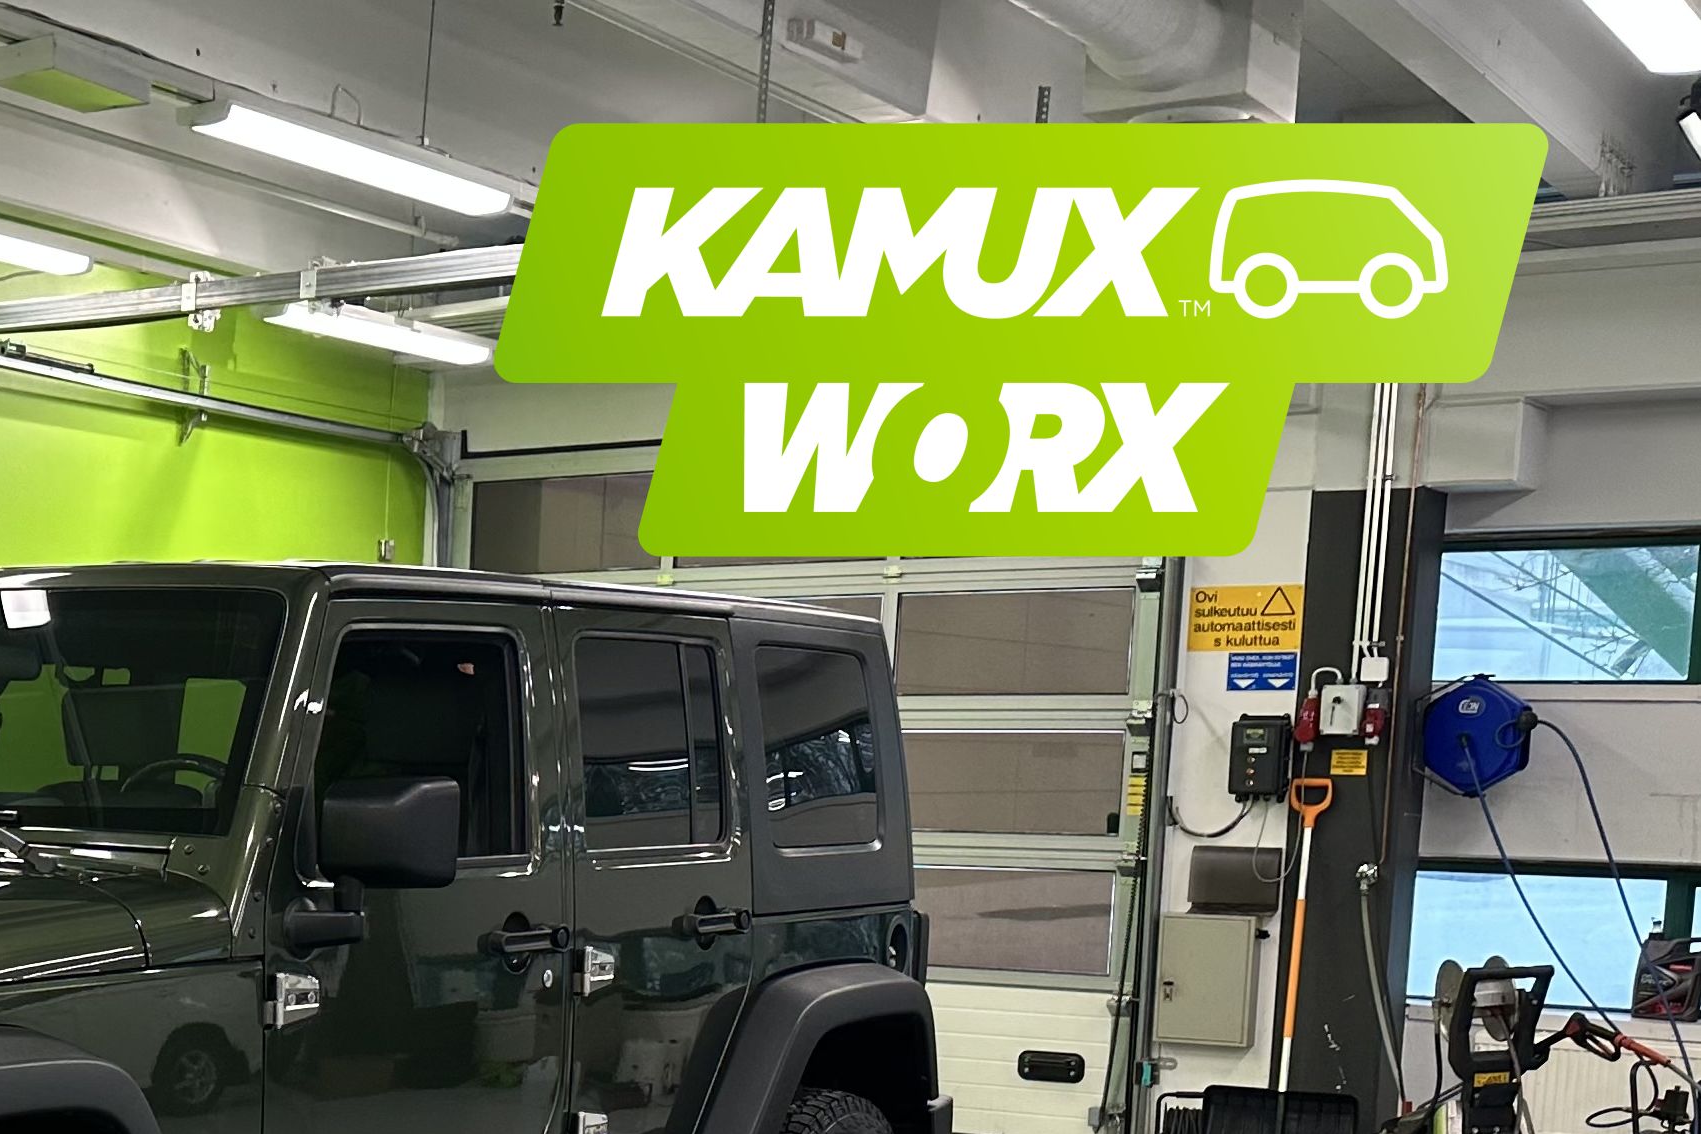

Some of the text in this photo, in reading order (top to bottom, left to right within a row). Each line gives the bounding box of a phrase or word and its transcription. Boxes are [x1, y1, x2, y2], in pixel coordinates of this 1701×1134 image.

[1195, 590, 1218, 603] Ovi
[1194, 606, 1257, 618] sulkeutuu
[1193, 619, 1296, 632] automaattisesti
[1213, 634, 1280, 647] s kuluttua
